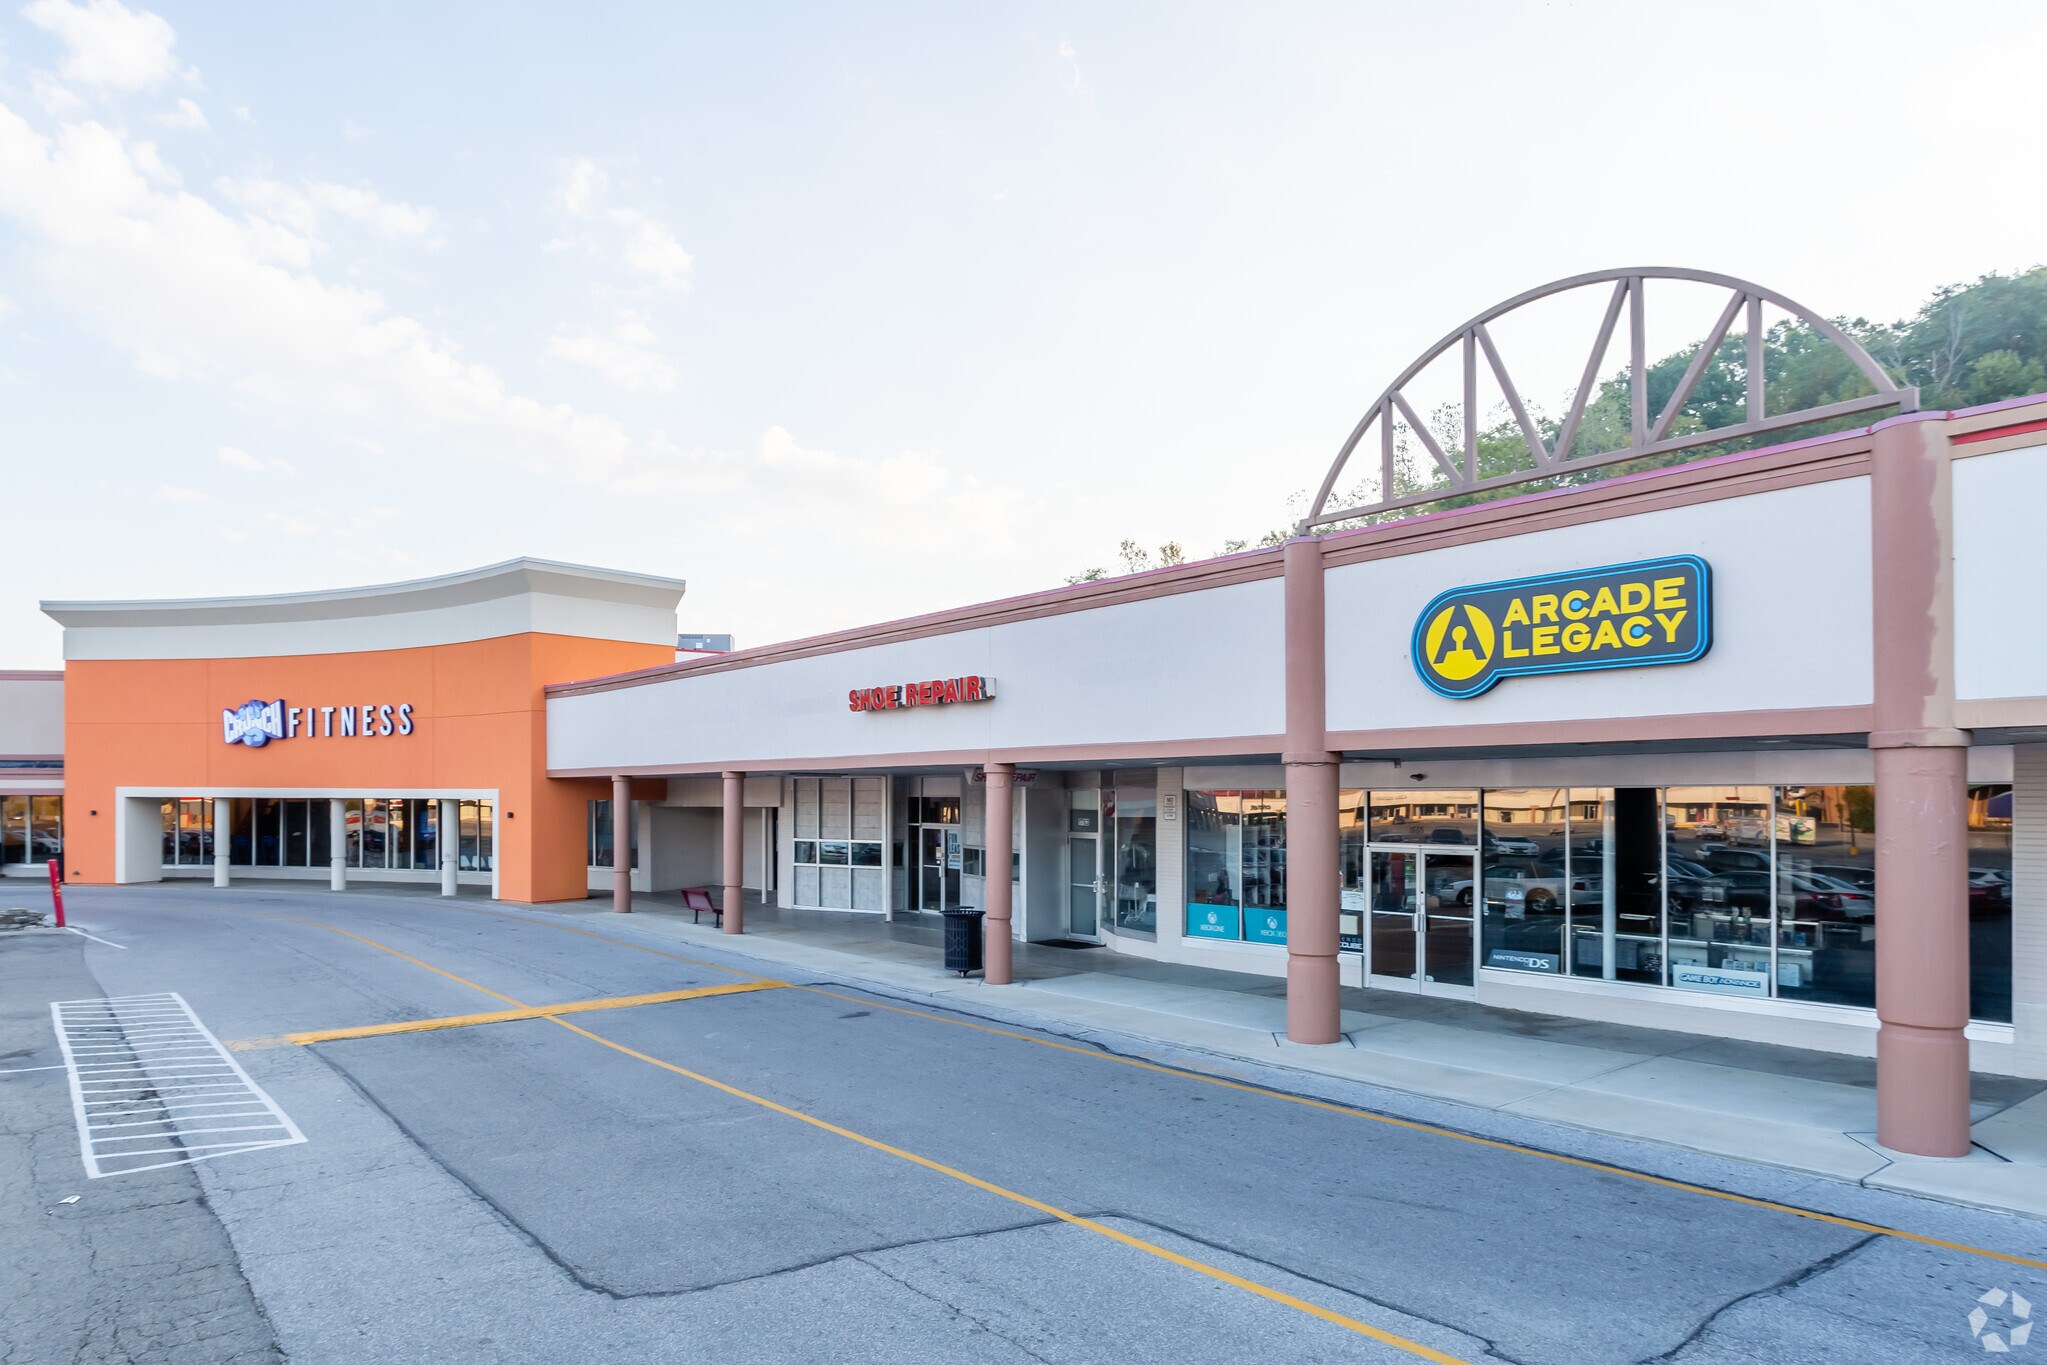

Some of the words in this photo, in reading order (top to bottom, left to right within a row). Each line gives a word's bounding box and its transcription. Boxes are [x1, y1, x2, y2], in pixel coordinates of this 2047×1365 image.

[1502, 577, 1687, 627] ARCADE
[1503, 610, 1688, 659] LEGACY
[849, 685, 899, 712] SHOE
[905, 676, 980, 707] REPAIR
[223, 699, 285, 744] CRUNCH
[289, 704, 413, 737] FITNESS
[975, 773, 986, 782] SH
[1012, 773, 1036, 782] EPAIR
[1492, 954, 1529, 963] NINTENDO
[1528, 957, 1550, 969] DS
[1680, 973, 1703, 983] GAME
[1703, 975, 1719, 985] BOY
[1719, 977, 1761, 988] ADVANCE
